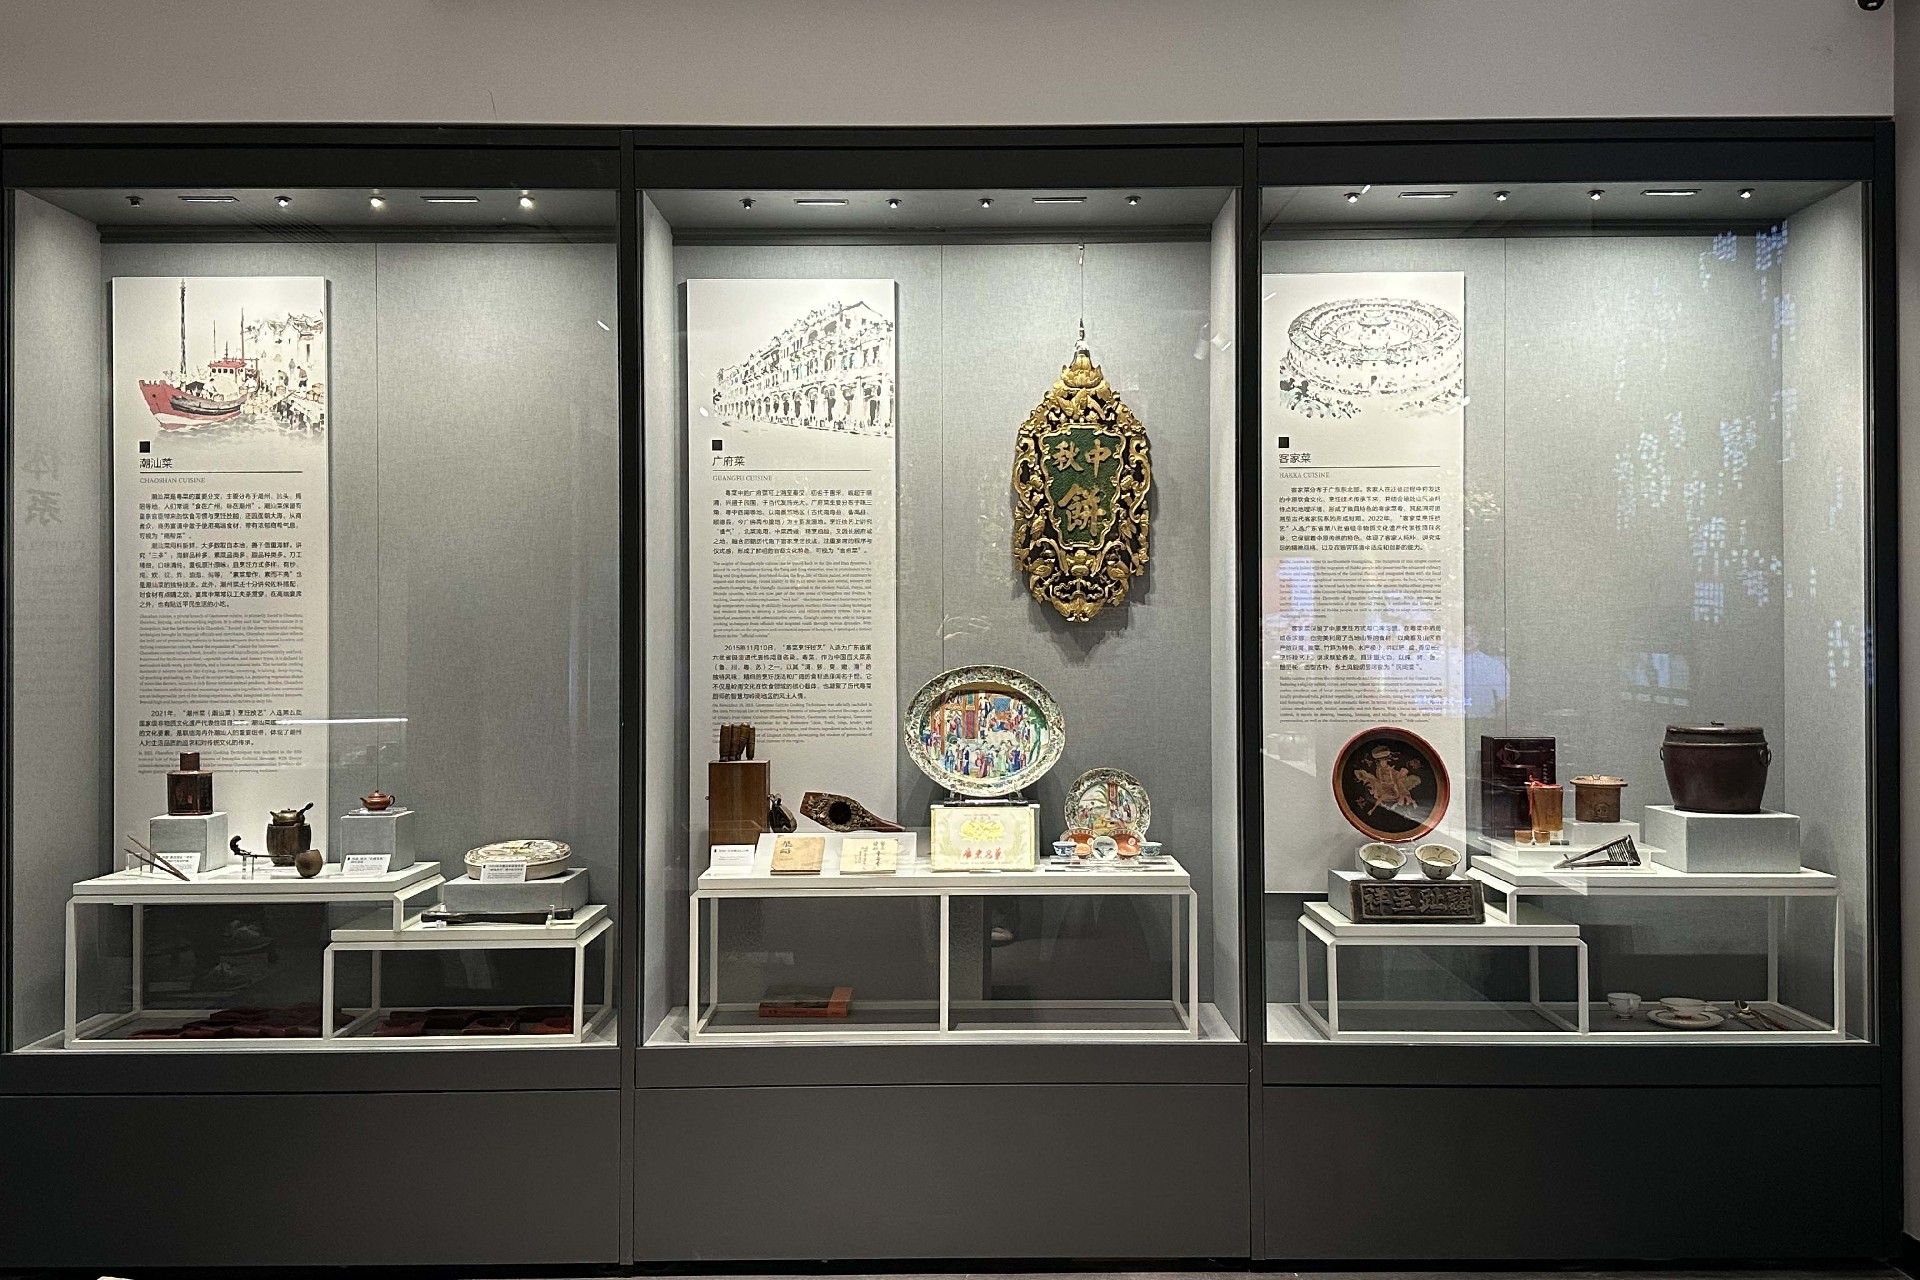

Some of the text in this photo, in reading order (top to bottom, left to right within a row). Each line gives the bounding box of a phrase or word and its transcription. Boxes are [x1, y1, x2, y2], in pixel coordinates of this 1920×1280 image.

[139, 458, 173, 469] 潮汕菜
[712, 456, 745, 467] 广府菜
[1051, 438, 1112, 479] 中秋
[1278, 453, 1312, 464] 客家菜
